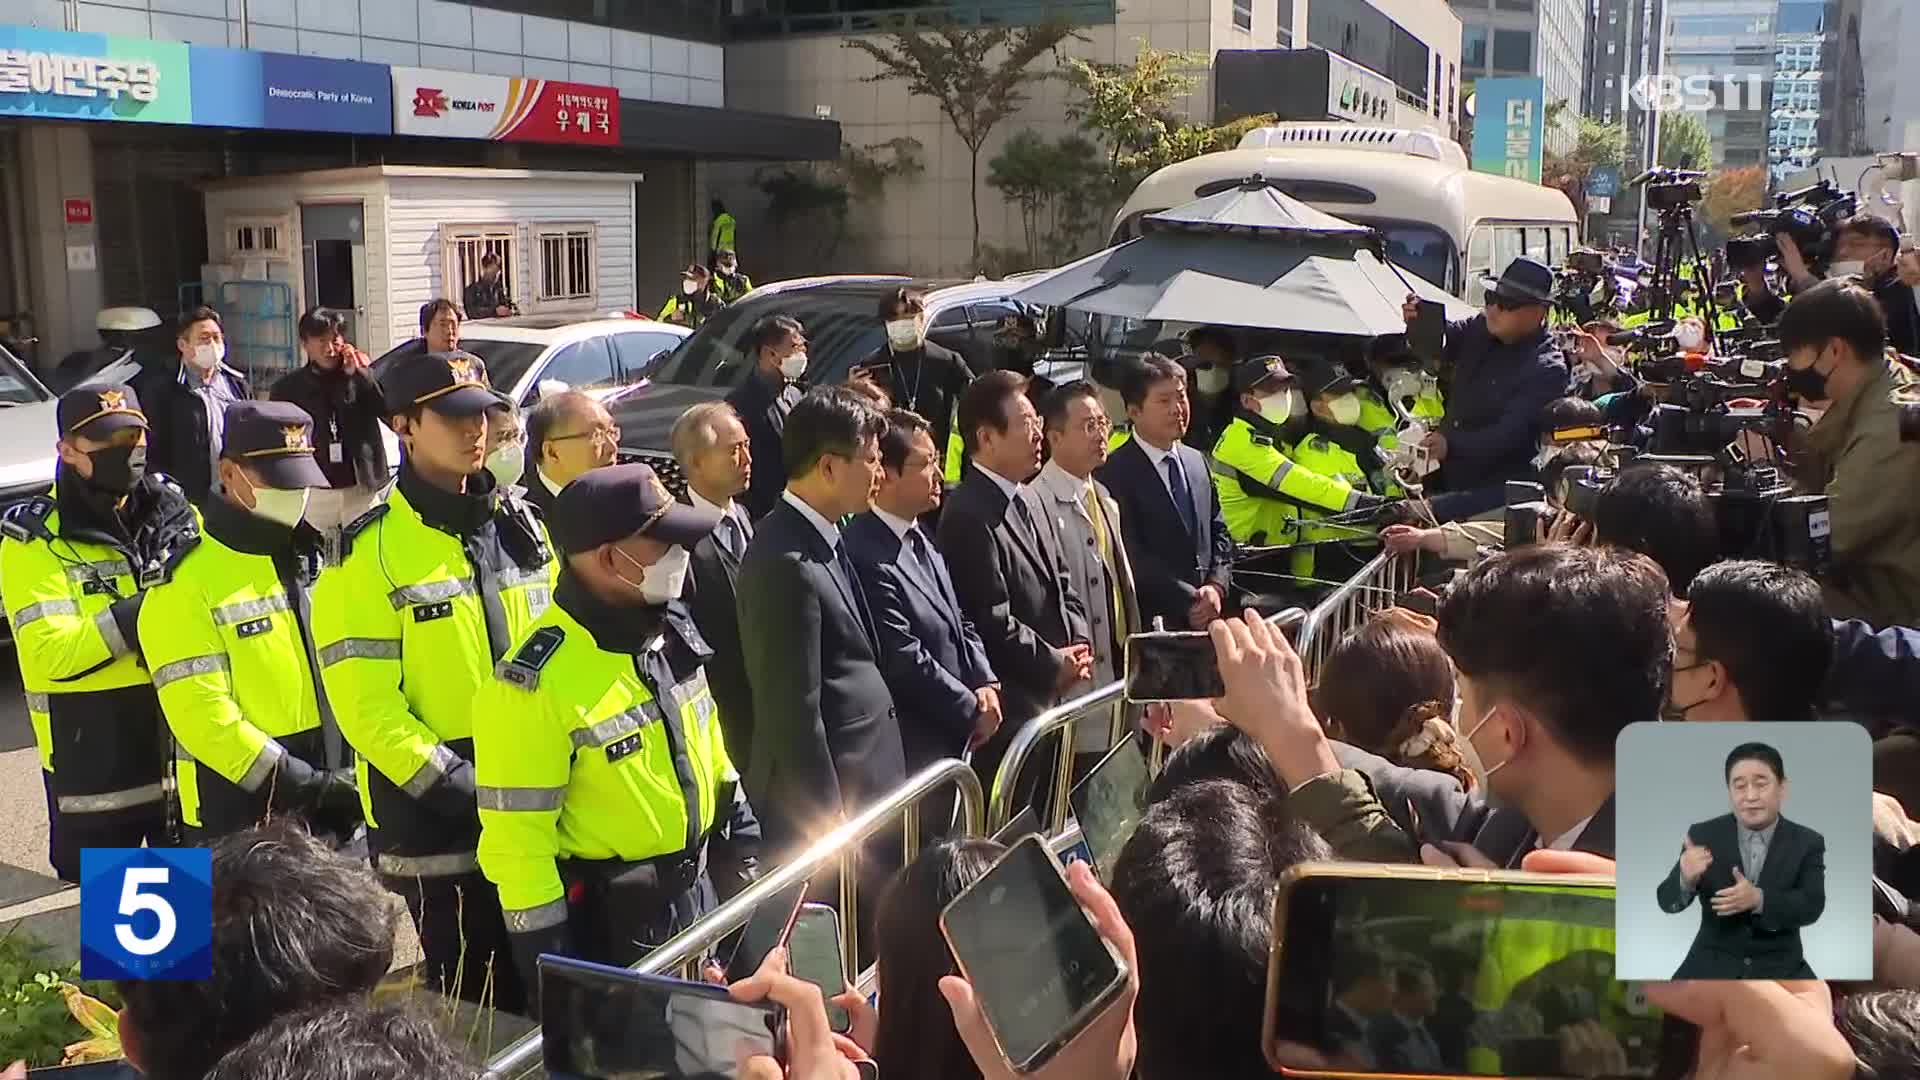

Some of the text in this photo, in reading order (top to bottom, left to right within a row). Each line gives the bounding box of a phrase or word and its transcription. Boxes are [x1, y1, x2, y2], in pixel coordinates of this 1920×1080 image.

[268, 87, 374, 104] Democratic Party of Korea
[452, 100, 496, 112] KOREA POST
[555, 109, 609, 135] 우체국
